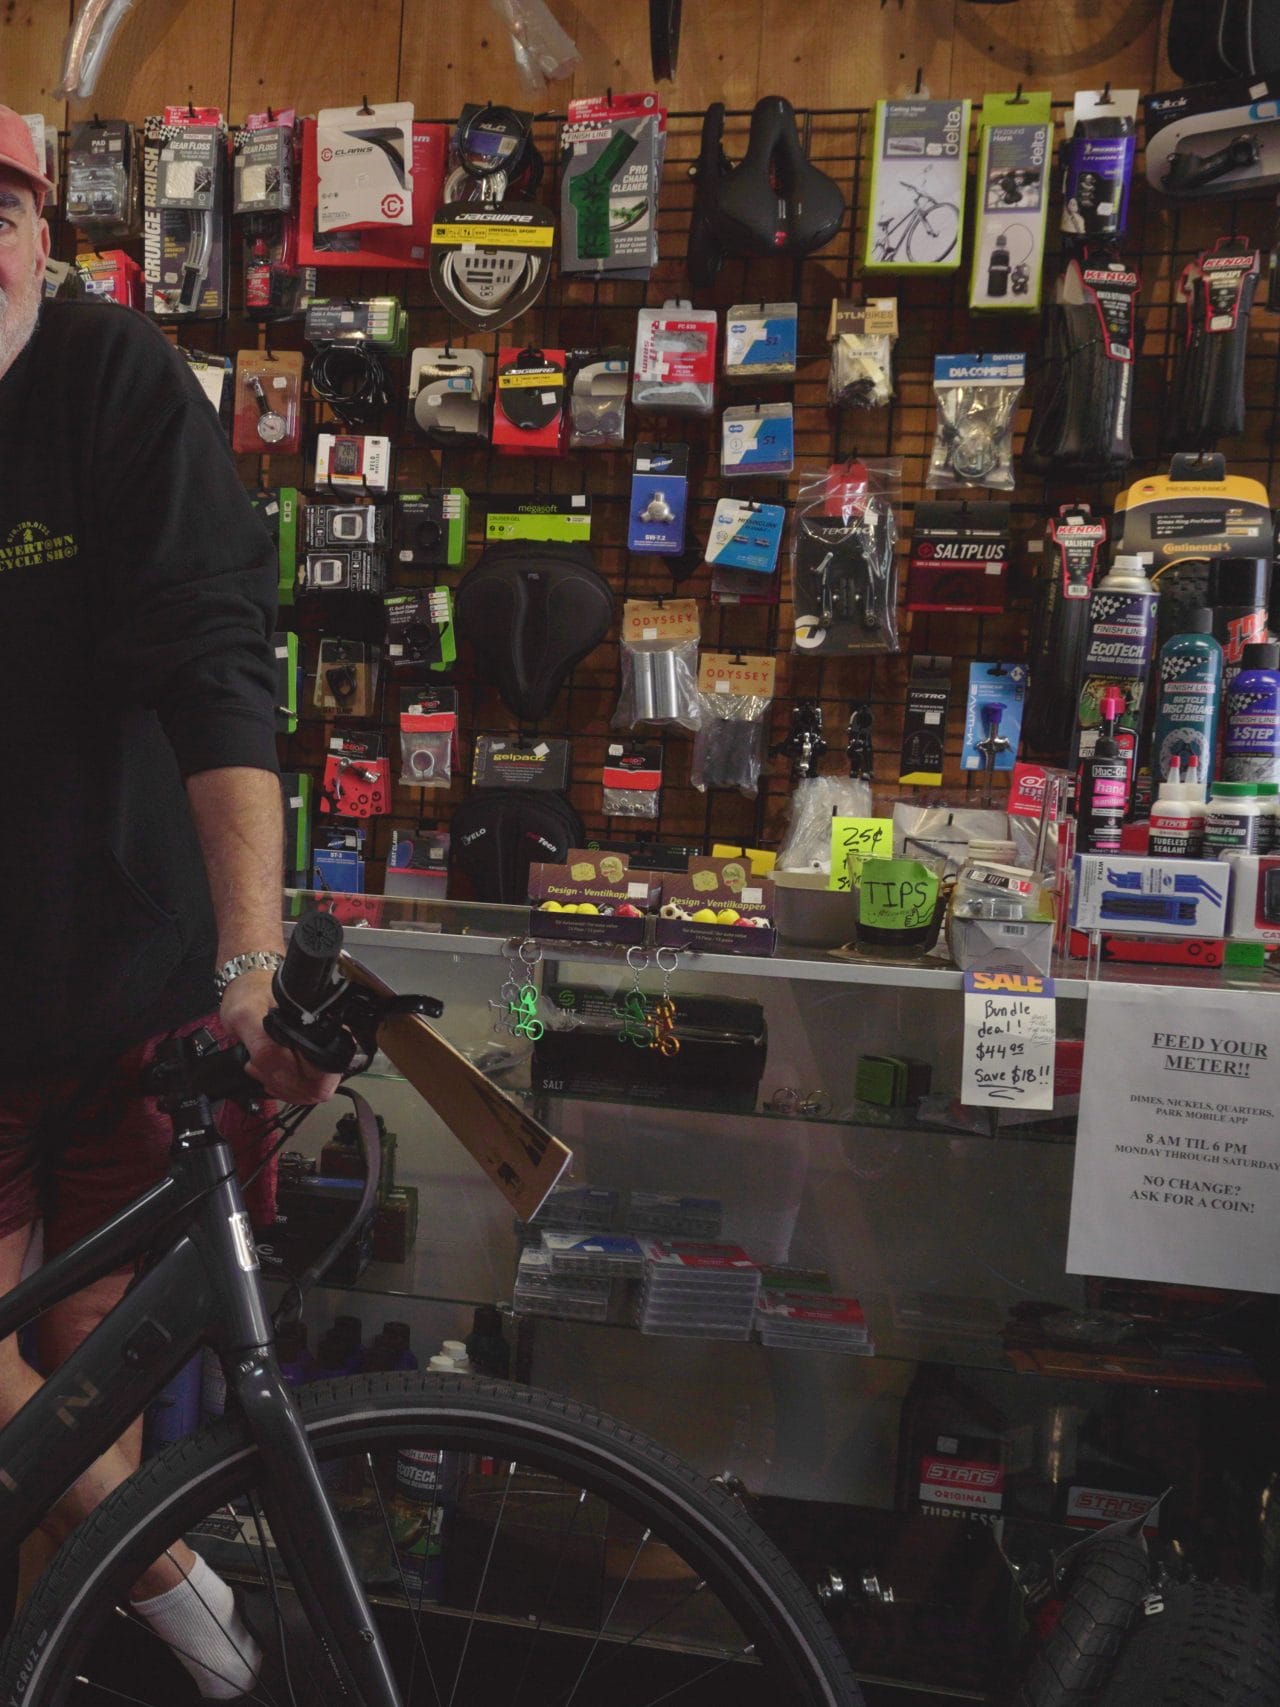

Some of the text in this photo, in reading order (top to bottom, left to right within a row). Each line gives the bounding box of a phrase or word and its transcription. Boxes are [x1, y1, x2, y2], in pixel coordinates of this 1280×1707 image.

[942, 109, 960, 156] delta
[334, 146, 374, 156] CLARKS
[1029, 130, 1046, 166] delta
[144, 147, 160, 208] BRUSH
[628, 164, 649, 174] PRO
[611, 182, 649, 193] CLEANER
[455, 212, 534, 223] JAGWIRE
[144, 210, 161, 283] GRUNGE
[1202, 256, 1254, 269] KENDA
[1084, 269, 1138, 282] KENDA
[46, 545, 80, 563] SHOP
[933, 542, 1006, 560] SALTPLUS
[632, 613, 692, 627] ODYSSEY
[706, 668, 769, 681] ODYSSEY
[910, 692, 947, 700] TEKTRO
[1232, 726, 1275, 740] 1-STEP
[1153, 836, 1188, 847] TUBELESS
[548, 885, 578, 897] Design
[864, 880, 929, 909] TIPS
[669, 897, 767, 911] Design Ventilkappen
[973, 971, 1043, 993] SALE
[985, 999, 1031, 1019] Bundle
[1151, 1032, 1269, 1060] FEED YOUR
[974, 1067, 1006, 1083] Save
[1163, 1054, 1252, 1079] METER!!
[542, 1079, 565, 1090] SALT
[1129, 1094, 1275, 1119] DIMES, NICKELS, QUARTERS,
[1155, 1107, 1249, 1125] PARK MOBILE APP
[1155, 1135, 1248, 1155] AM TIL PM
[1114, 1143, 1280, 1172] MONDAY THROUGH SATURDAY
[1142, 1174, 1242, 1197] NO CHANGE?
[1129, 1189, 1256, 1214] ASK FOR COIN!
[928, 1464, 999, 1485] STANS
[934, 1490, 988, 1504] ORIGINAL
[15, 1647, 40, 1693] CRUZ
